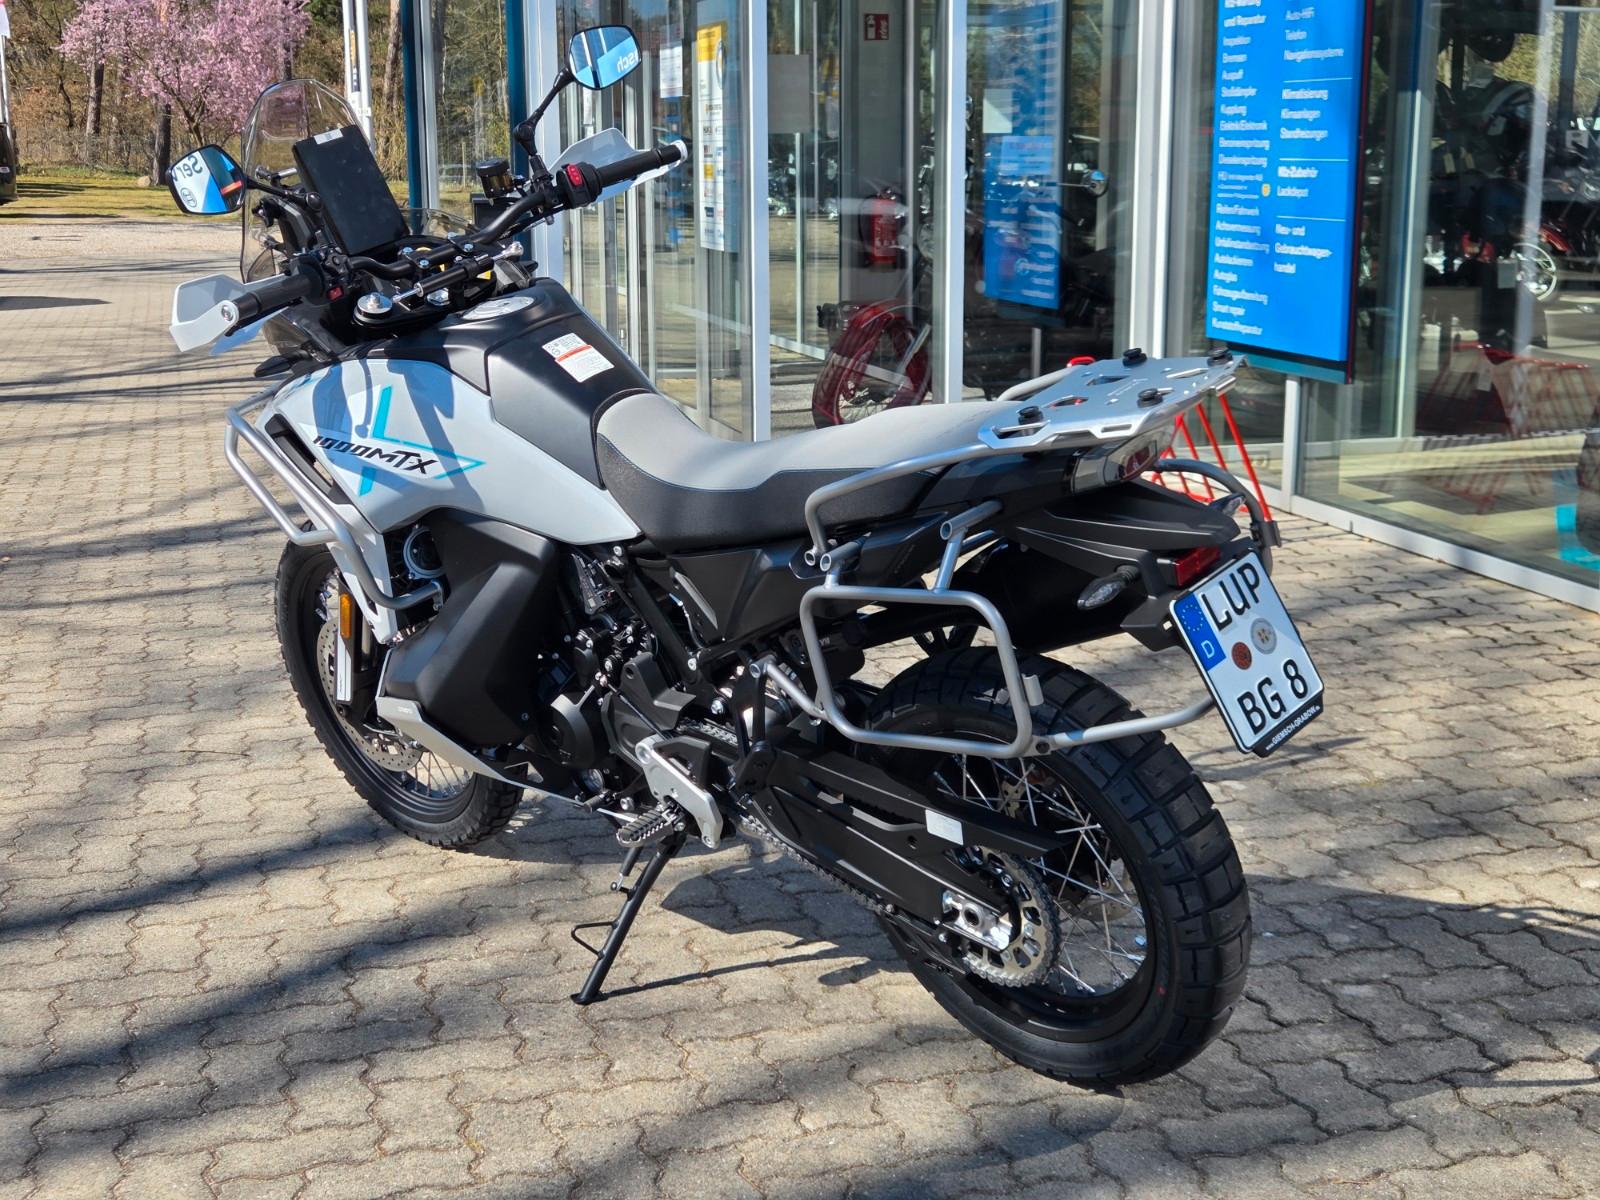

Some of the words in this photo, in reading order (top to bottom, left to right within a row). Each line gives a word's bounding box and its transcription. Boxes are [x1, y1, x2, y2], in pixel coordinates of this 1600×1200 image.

[1201, 562, 1260, 631] LUP
[1201, 640, 1215, 659] D
[1237, 676, 1287, 735] BG
[1282, 659, 1308, 699] 8
